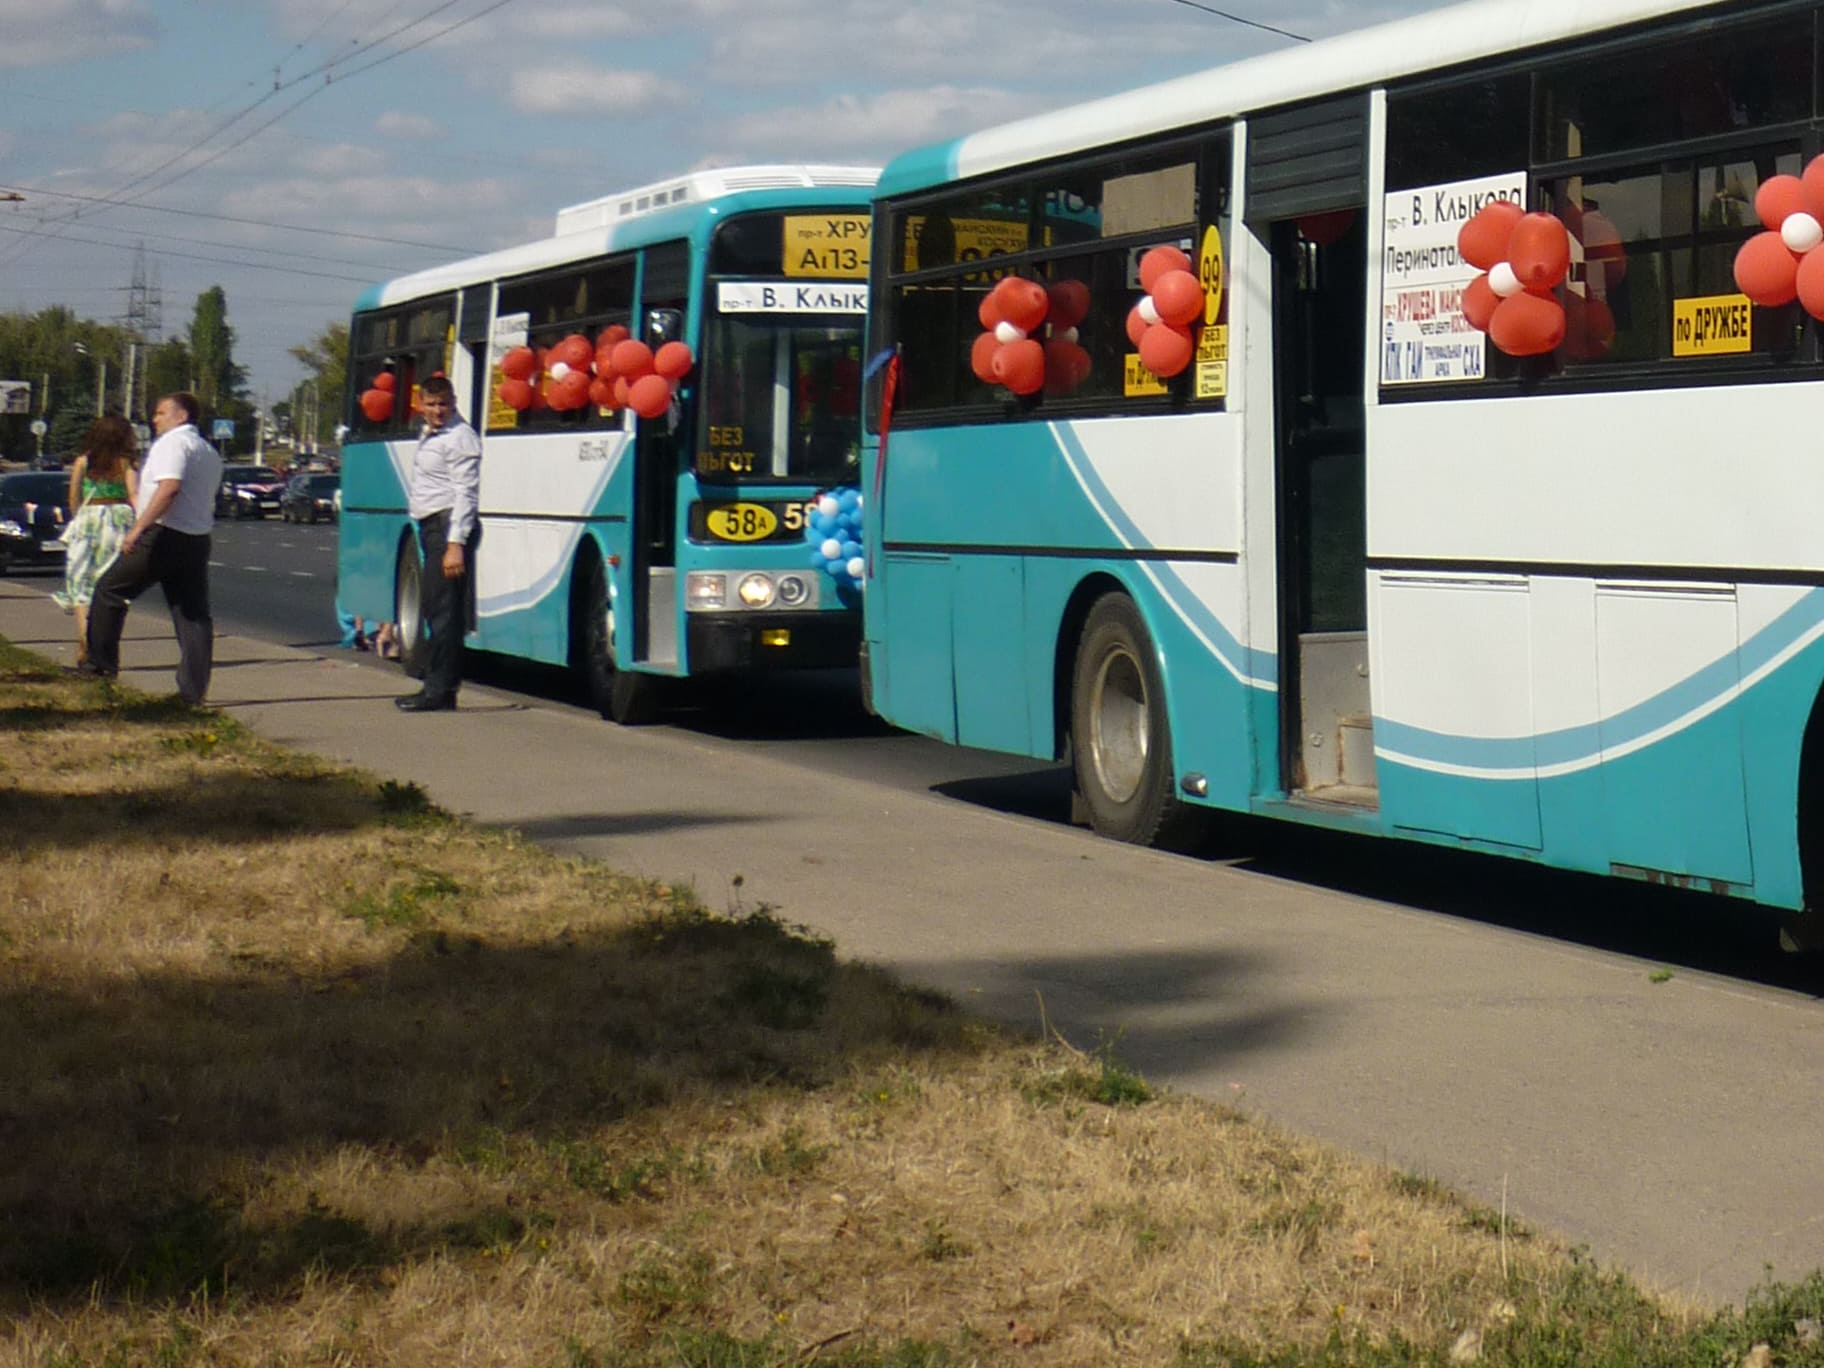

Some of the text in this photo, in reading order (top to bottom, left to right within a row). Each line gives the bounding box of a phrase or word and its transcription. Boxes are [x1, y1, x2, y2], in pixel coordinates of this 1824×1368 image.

[1202, 253, 1221, 297] 99
[762, 287, 785, 309] В.
[1677, 304, 1748, 348] по ДРУЖБЕ
[709, 426, 743, 446] БЕЗ
